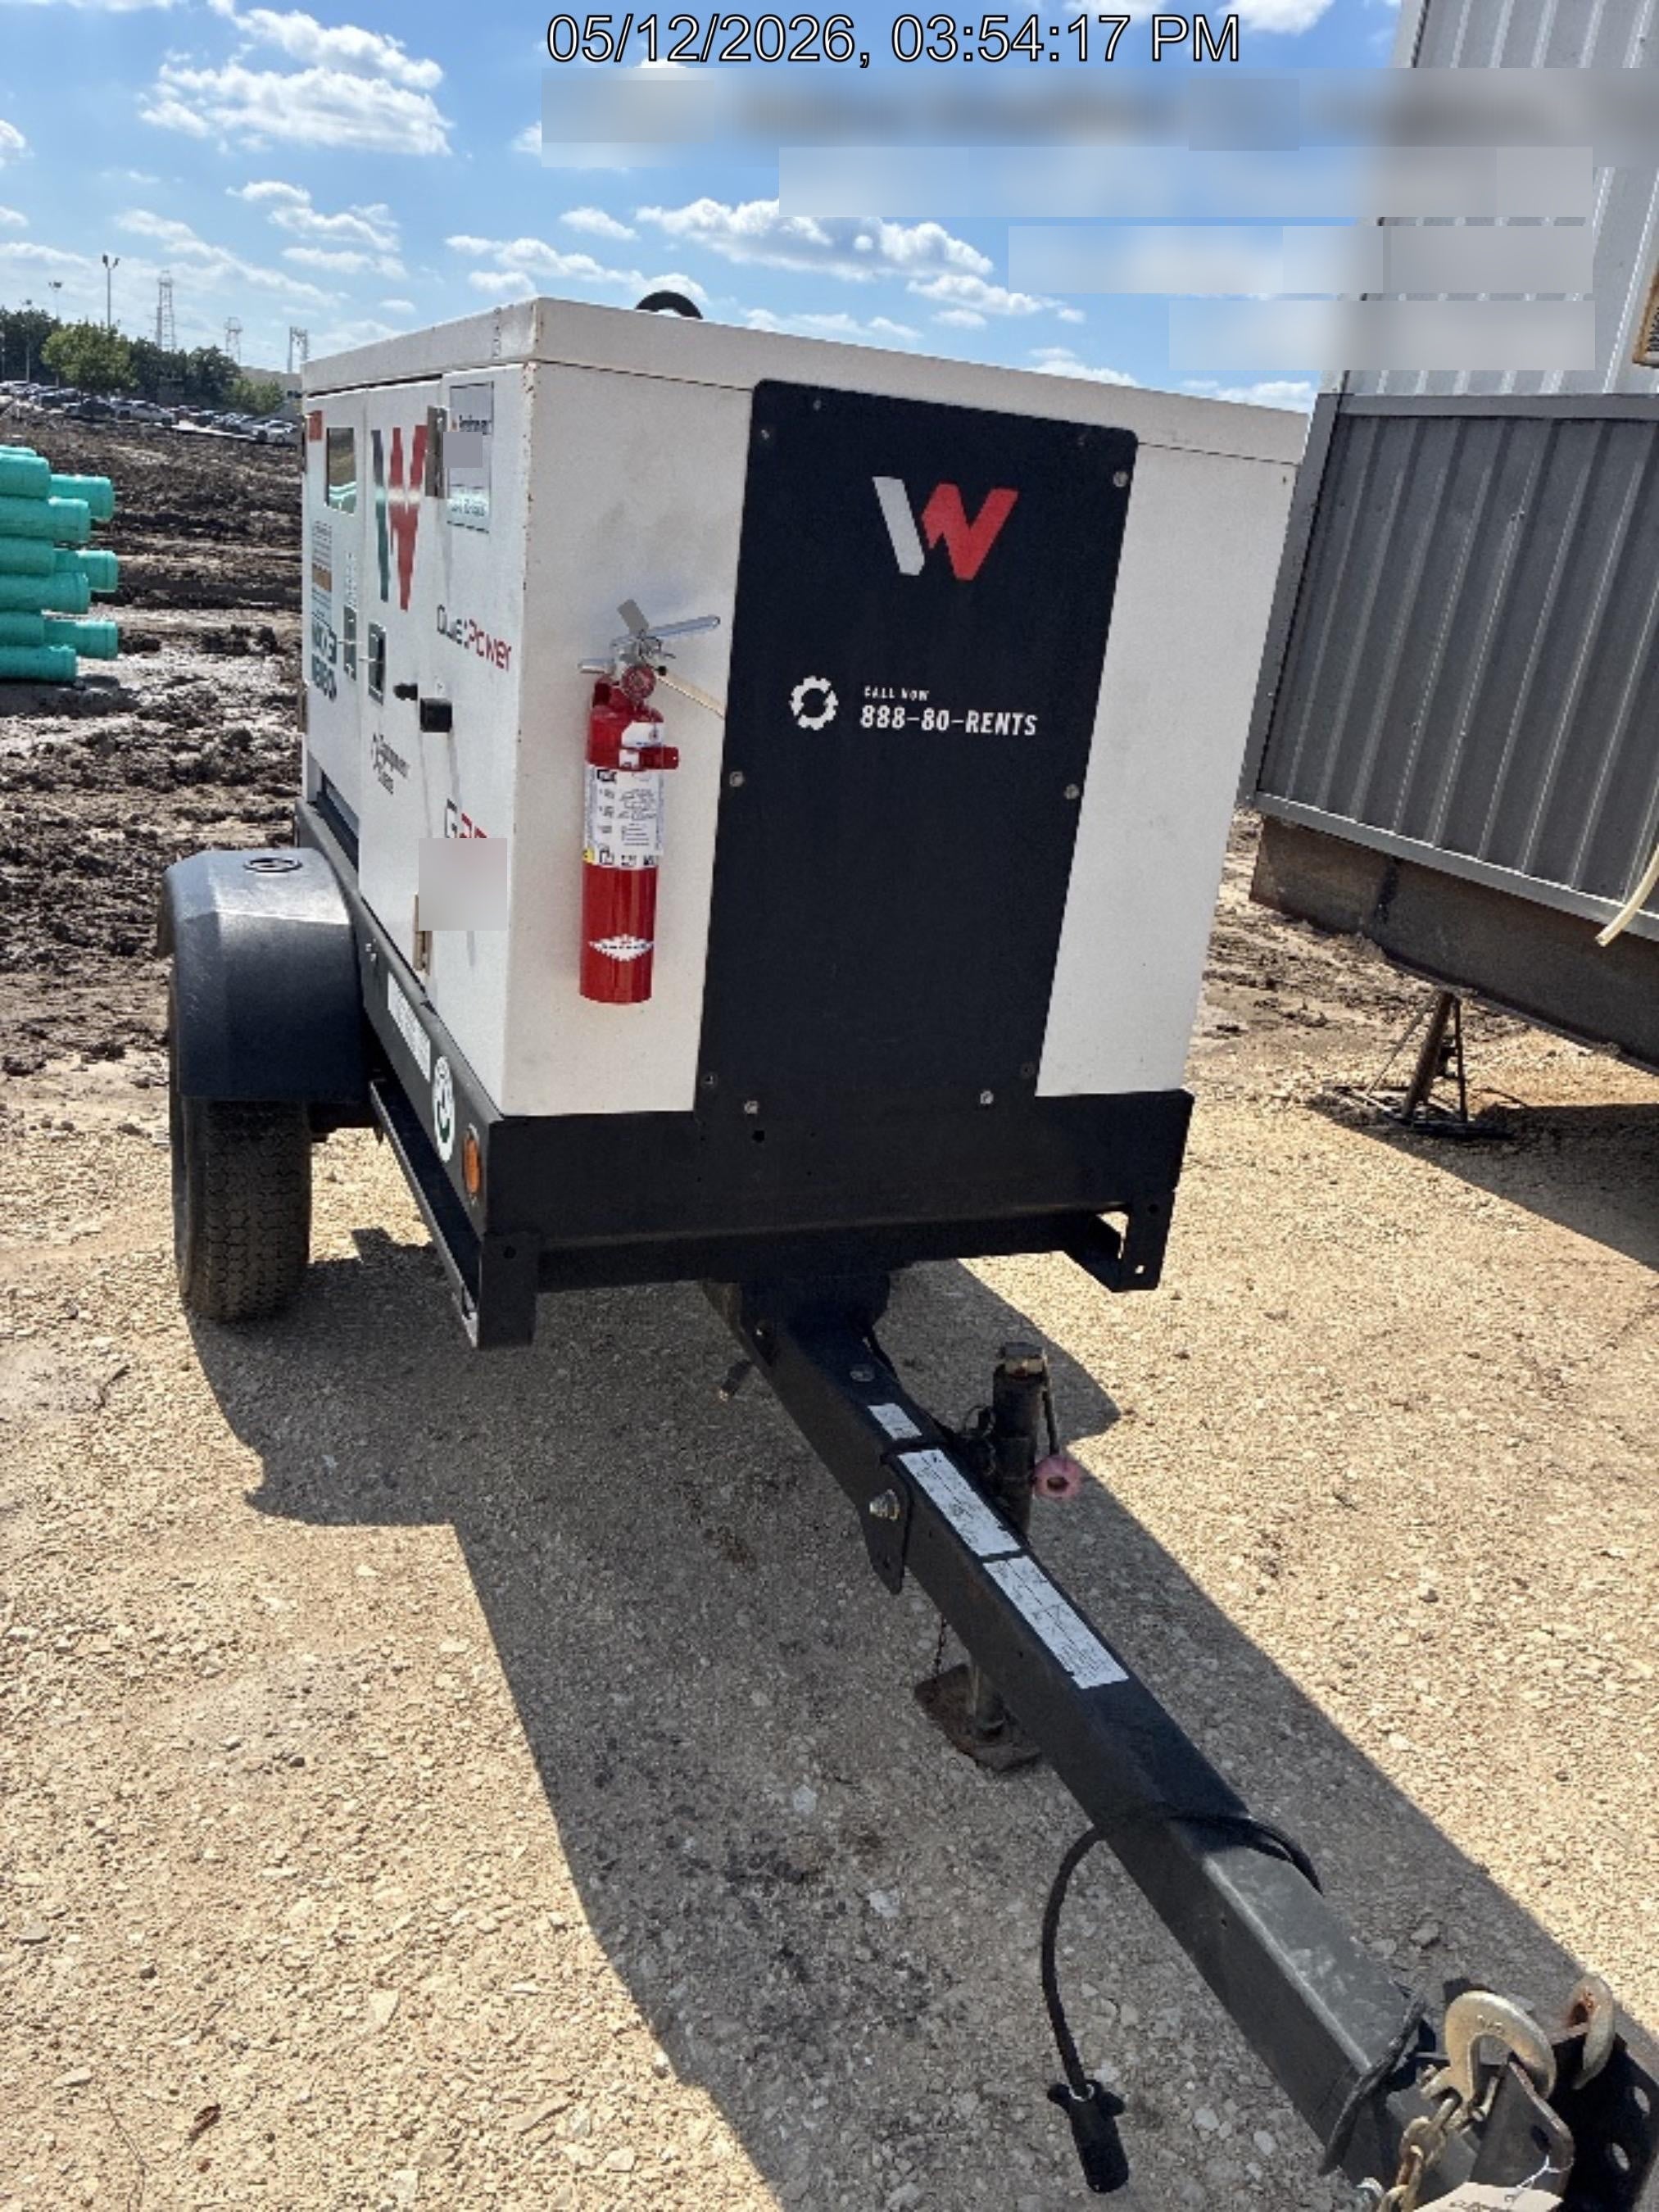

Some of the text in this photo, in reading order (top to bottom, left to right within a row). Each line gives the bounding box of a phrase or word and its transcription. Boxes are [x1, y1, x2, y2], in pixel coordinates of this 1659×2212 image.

[864, 685, 930, 701] CALL NOW
[860, 704, 1039, 737] 888-80-RENTS
